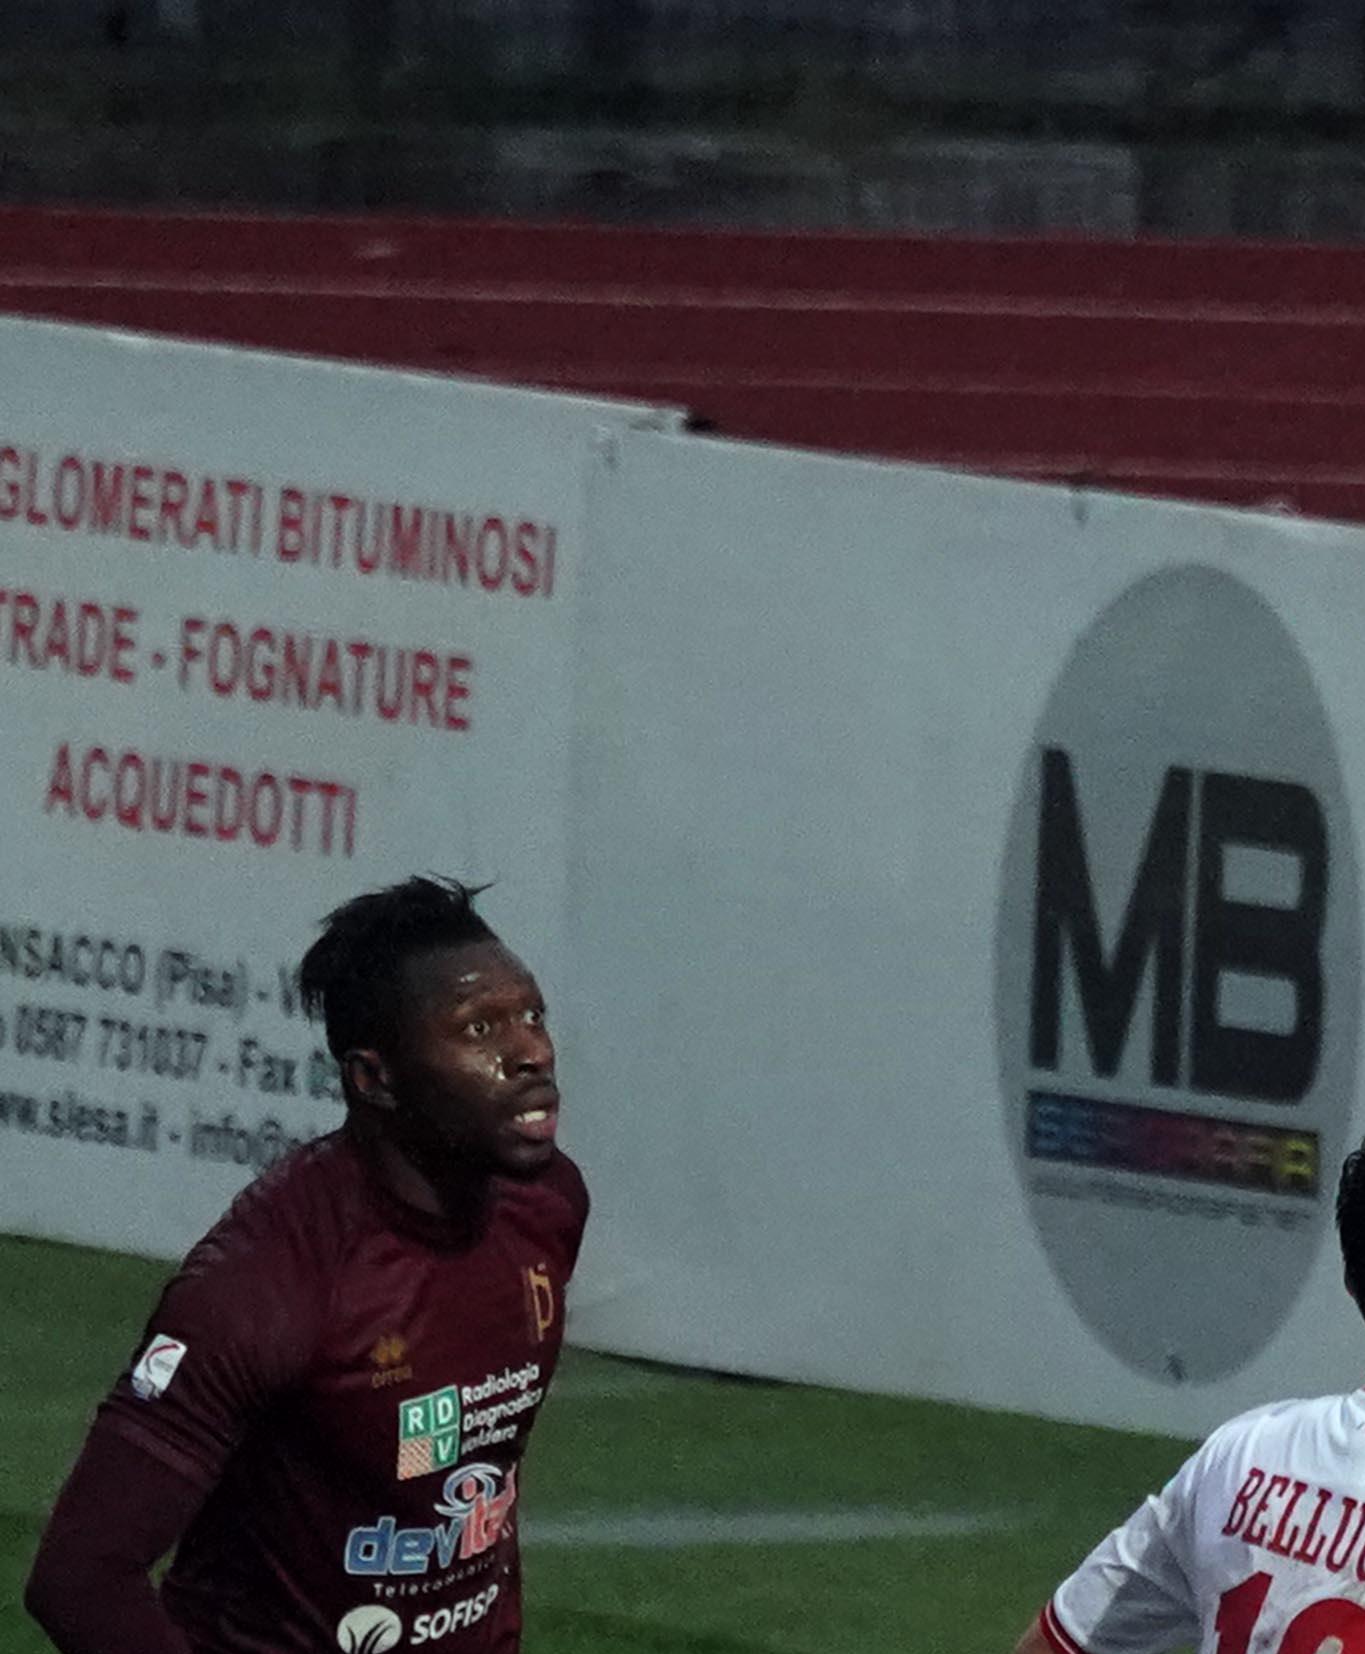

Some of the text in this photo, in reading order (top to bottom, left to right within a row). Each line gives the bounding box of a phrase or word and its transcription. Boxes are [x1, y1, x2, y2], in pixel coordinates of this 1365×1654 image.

[276, 487, 558, 599] BITUMINOSI
[179, 616, 472, 733] FOGNATURE
[45, 742, 360, 858] ACQUEDOTTI
[1029, 747, 1329, 1106] MB
